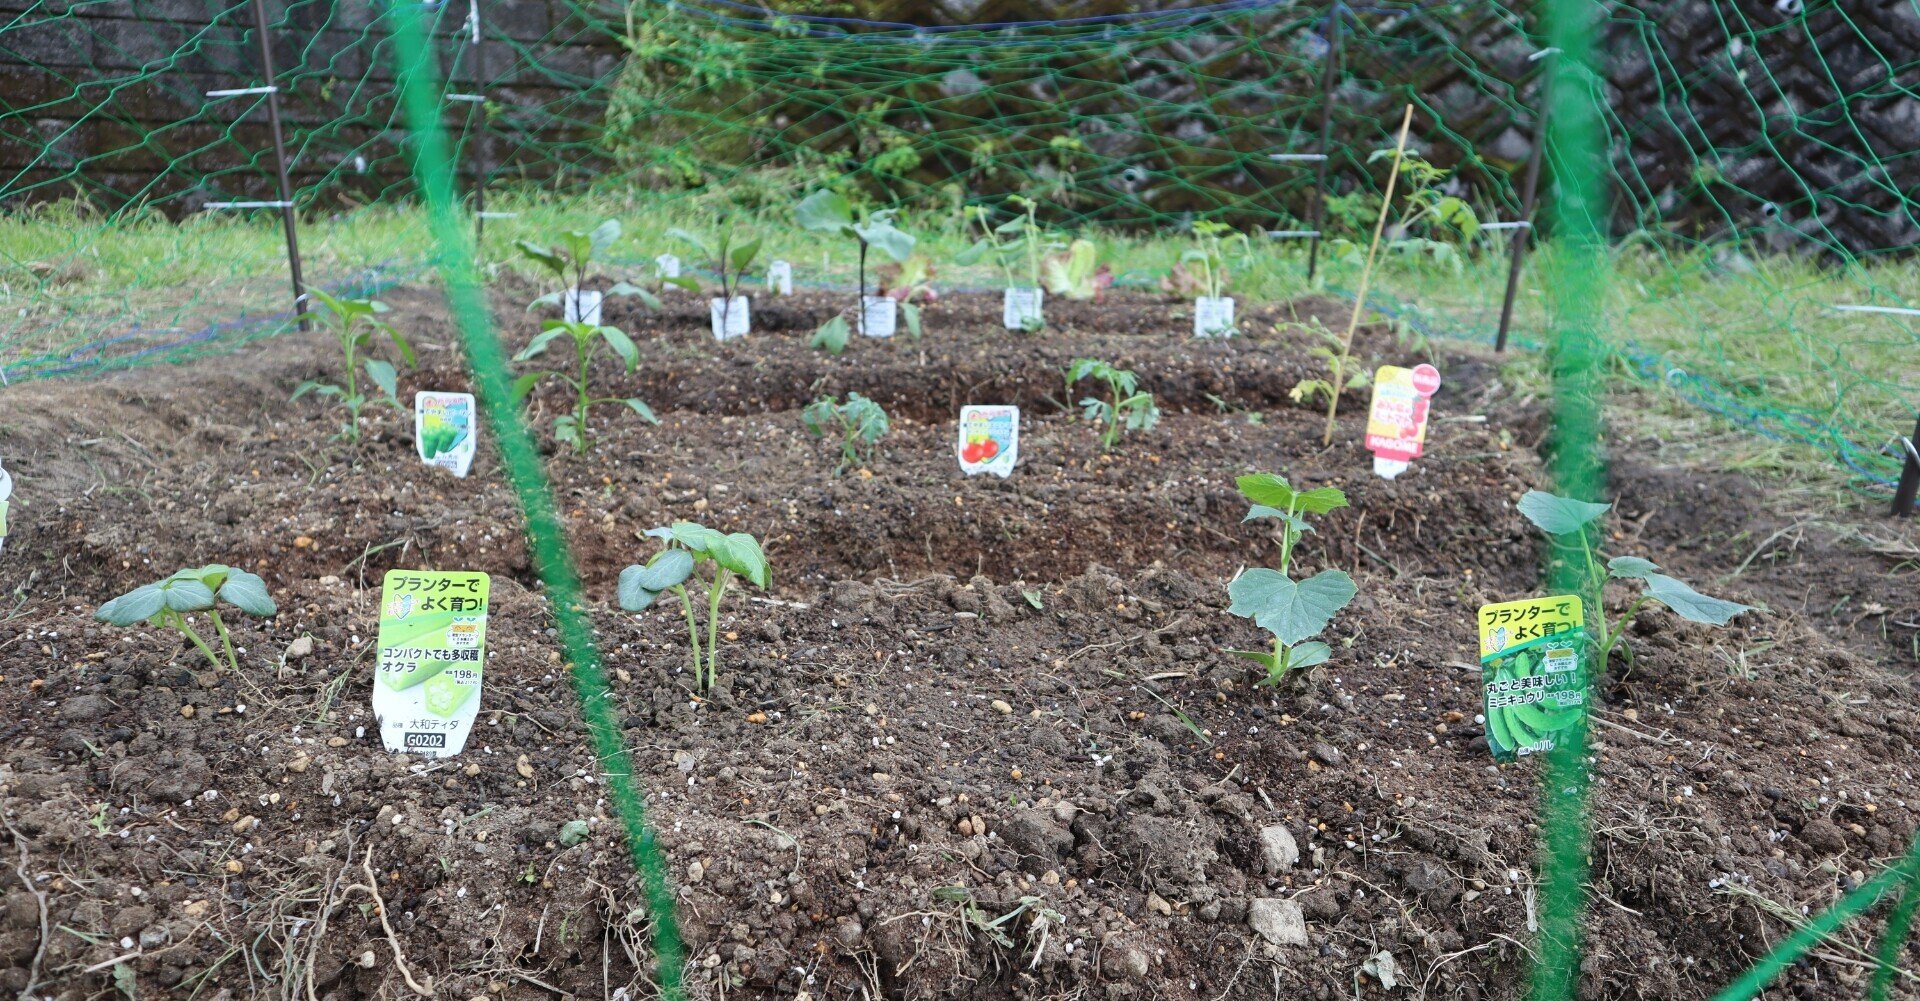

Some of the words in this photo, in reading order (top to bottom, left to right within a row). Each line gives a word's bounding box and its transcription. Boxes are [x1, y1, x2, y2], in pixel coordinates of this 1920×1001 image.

[393, 576, 480, 593] プランターで
[421, 596, 483, 612] よく育つ!
[1485, 602, 1571, 626] プランターで
[1514, 620, 1577, 641] よく育つ!
[383, 648, 480, 662] コンパクトでも多収穫
[382, 662, 417, 673] オクラ
[1488, 691, 1545, 708] ミニキュウリ
[409, 719, 459, 730] 大和ティダ
[406, 734, 443, 747] G0202
